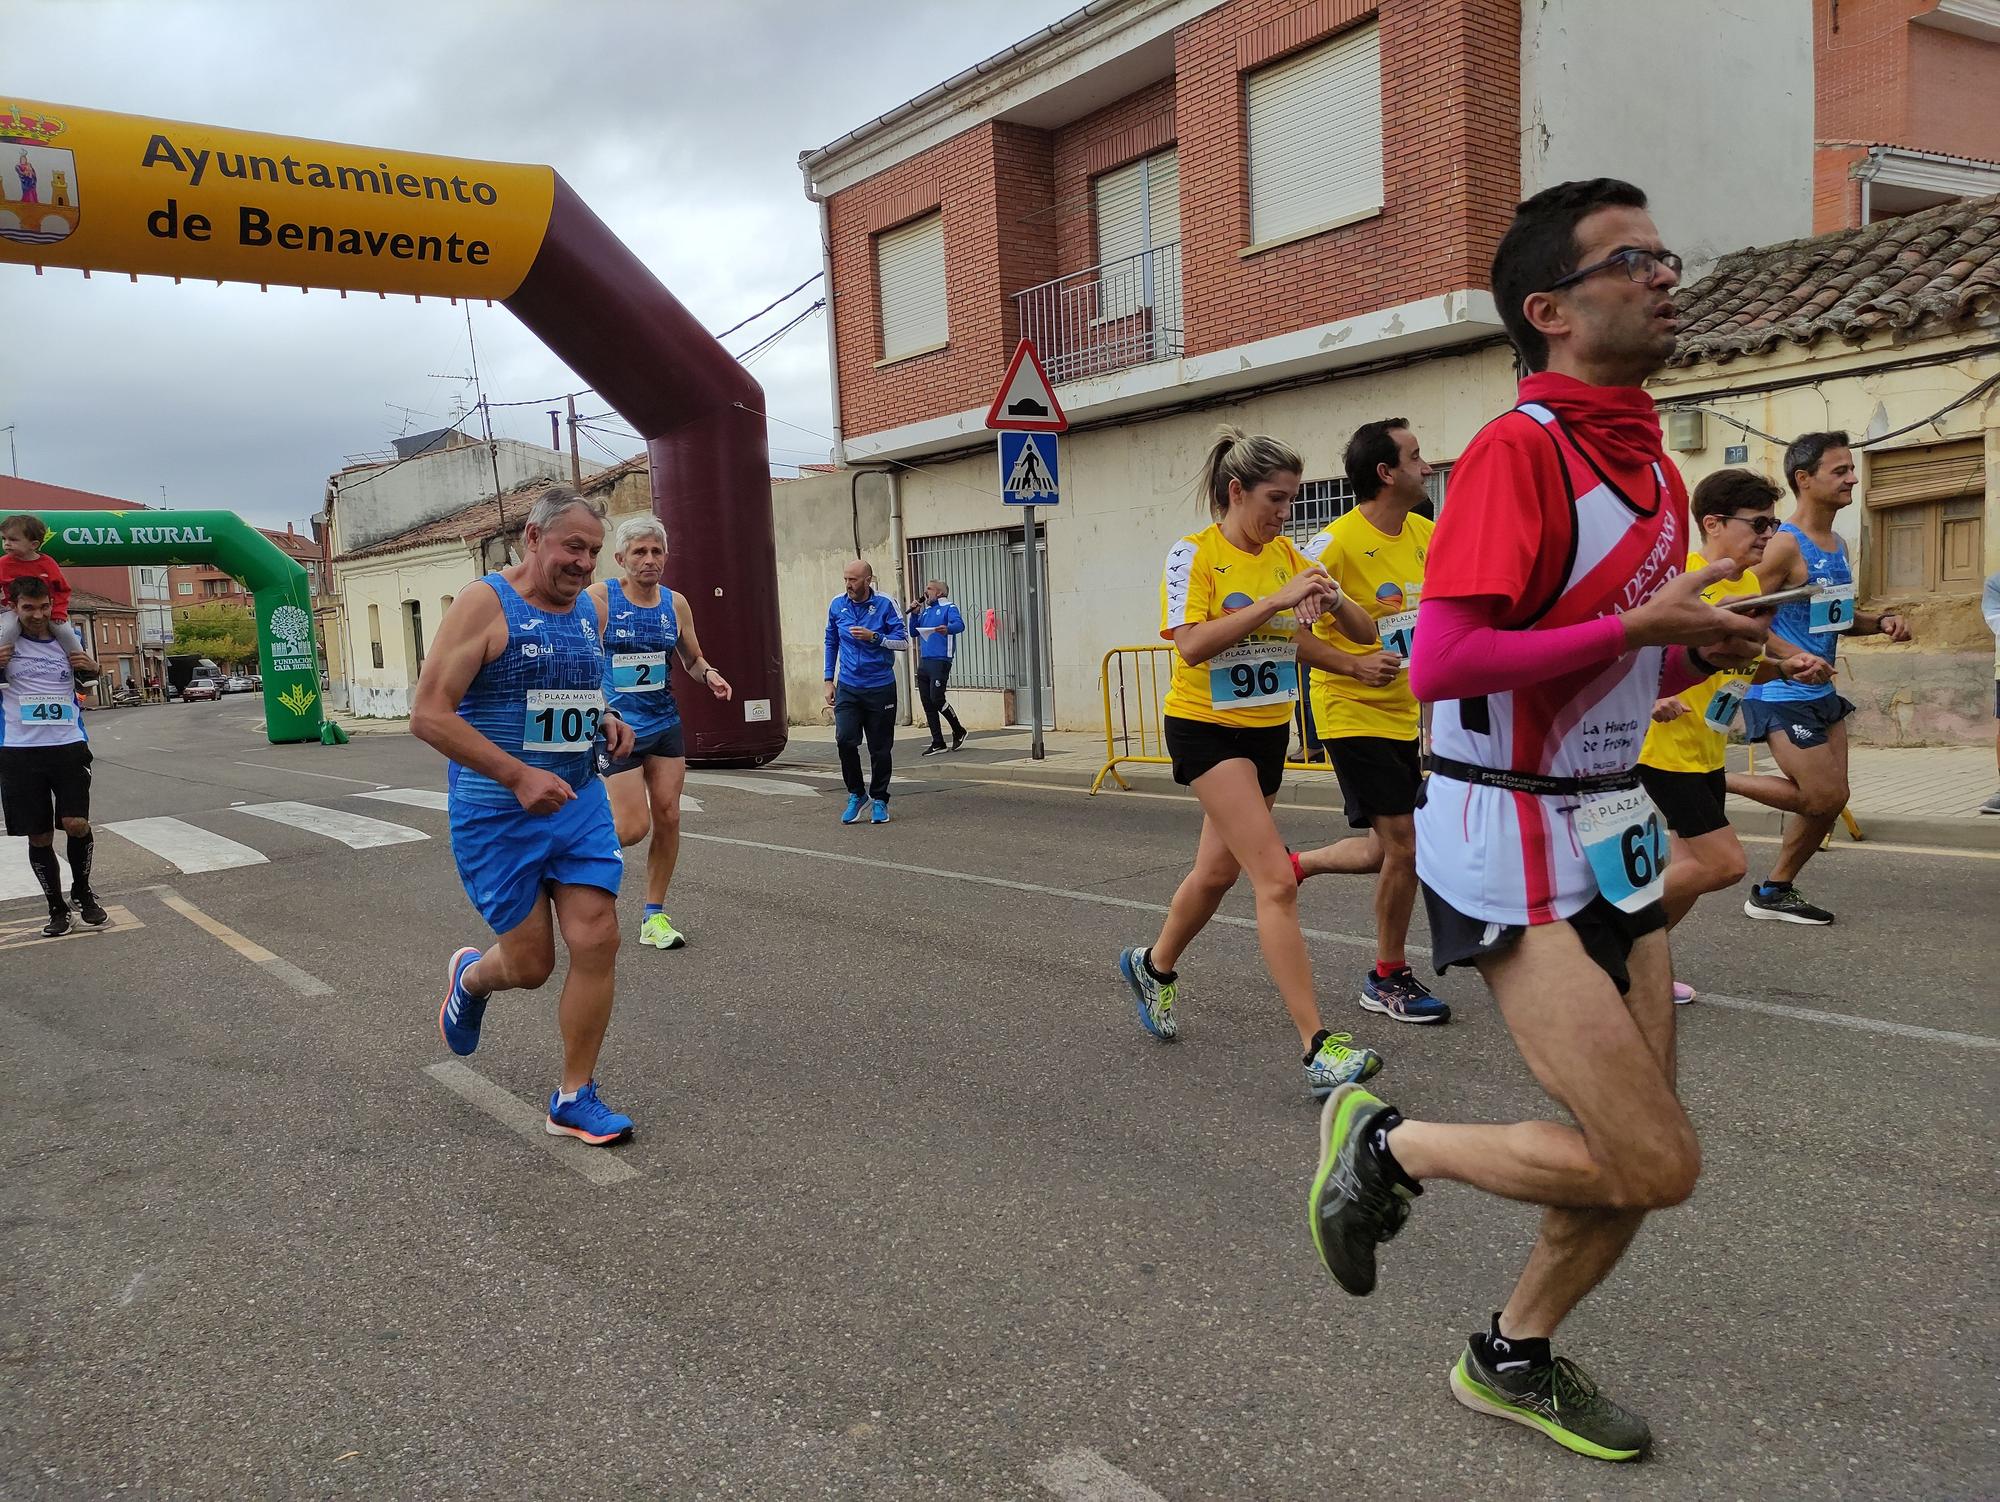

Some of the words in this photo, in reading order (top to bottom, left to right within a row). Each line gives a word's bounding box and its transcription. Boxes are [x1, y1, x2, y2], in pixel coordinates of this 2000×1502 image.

[141, 134, 498, 205] Ayuntamiento
[147, 199, 212, 242] de
[239, 206, 490, 265] Benavente
[63, 527, 123, 545] CAJA
[130, 526, 212, 544] RURAL
[1391, 614, 1412, 624] PLAZA
[1828, 599, 1842, 624] 6
[1225, 650, 1252, 659] PLAZA
[1254, 646, 1282, 655] MAYOR
[635, 664, 651, 686] 2
[1230, 661, 1279, 698] 96
[32, 703, 63, 720] 49
[535, 707, 600, 742] 103
[1583, 721, 1600, 735] La
[1583, 741, 1598, 753] de
[1481, 772, 1557, 788] performance
[1598, 797, 1641, 818] PLAZA
[1621, 811, 1665, 888] 62
